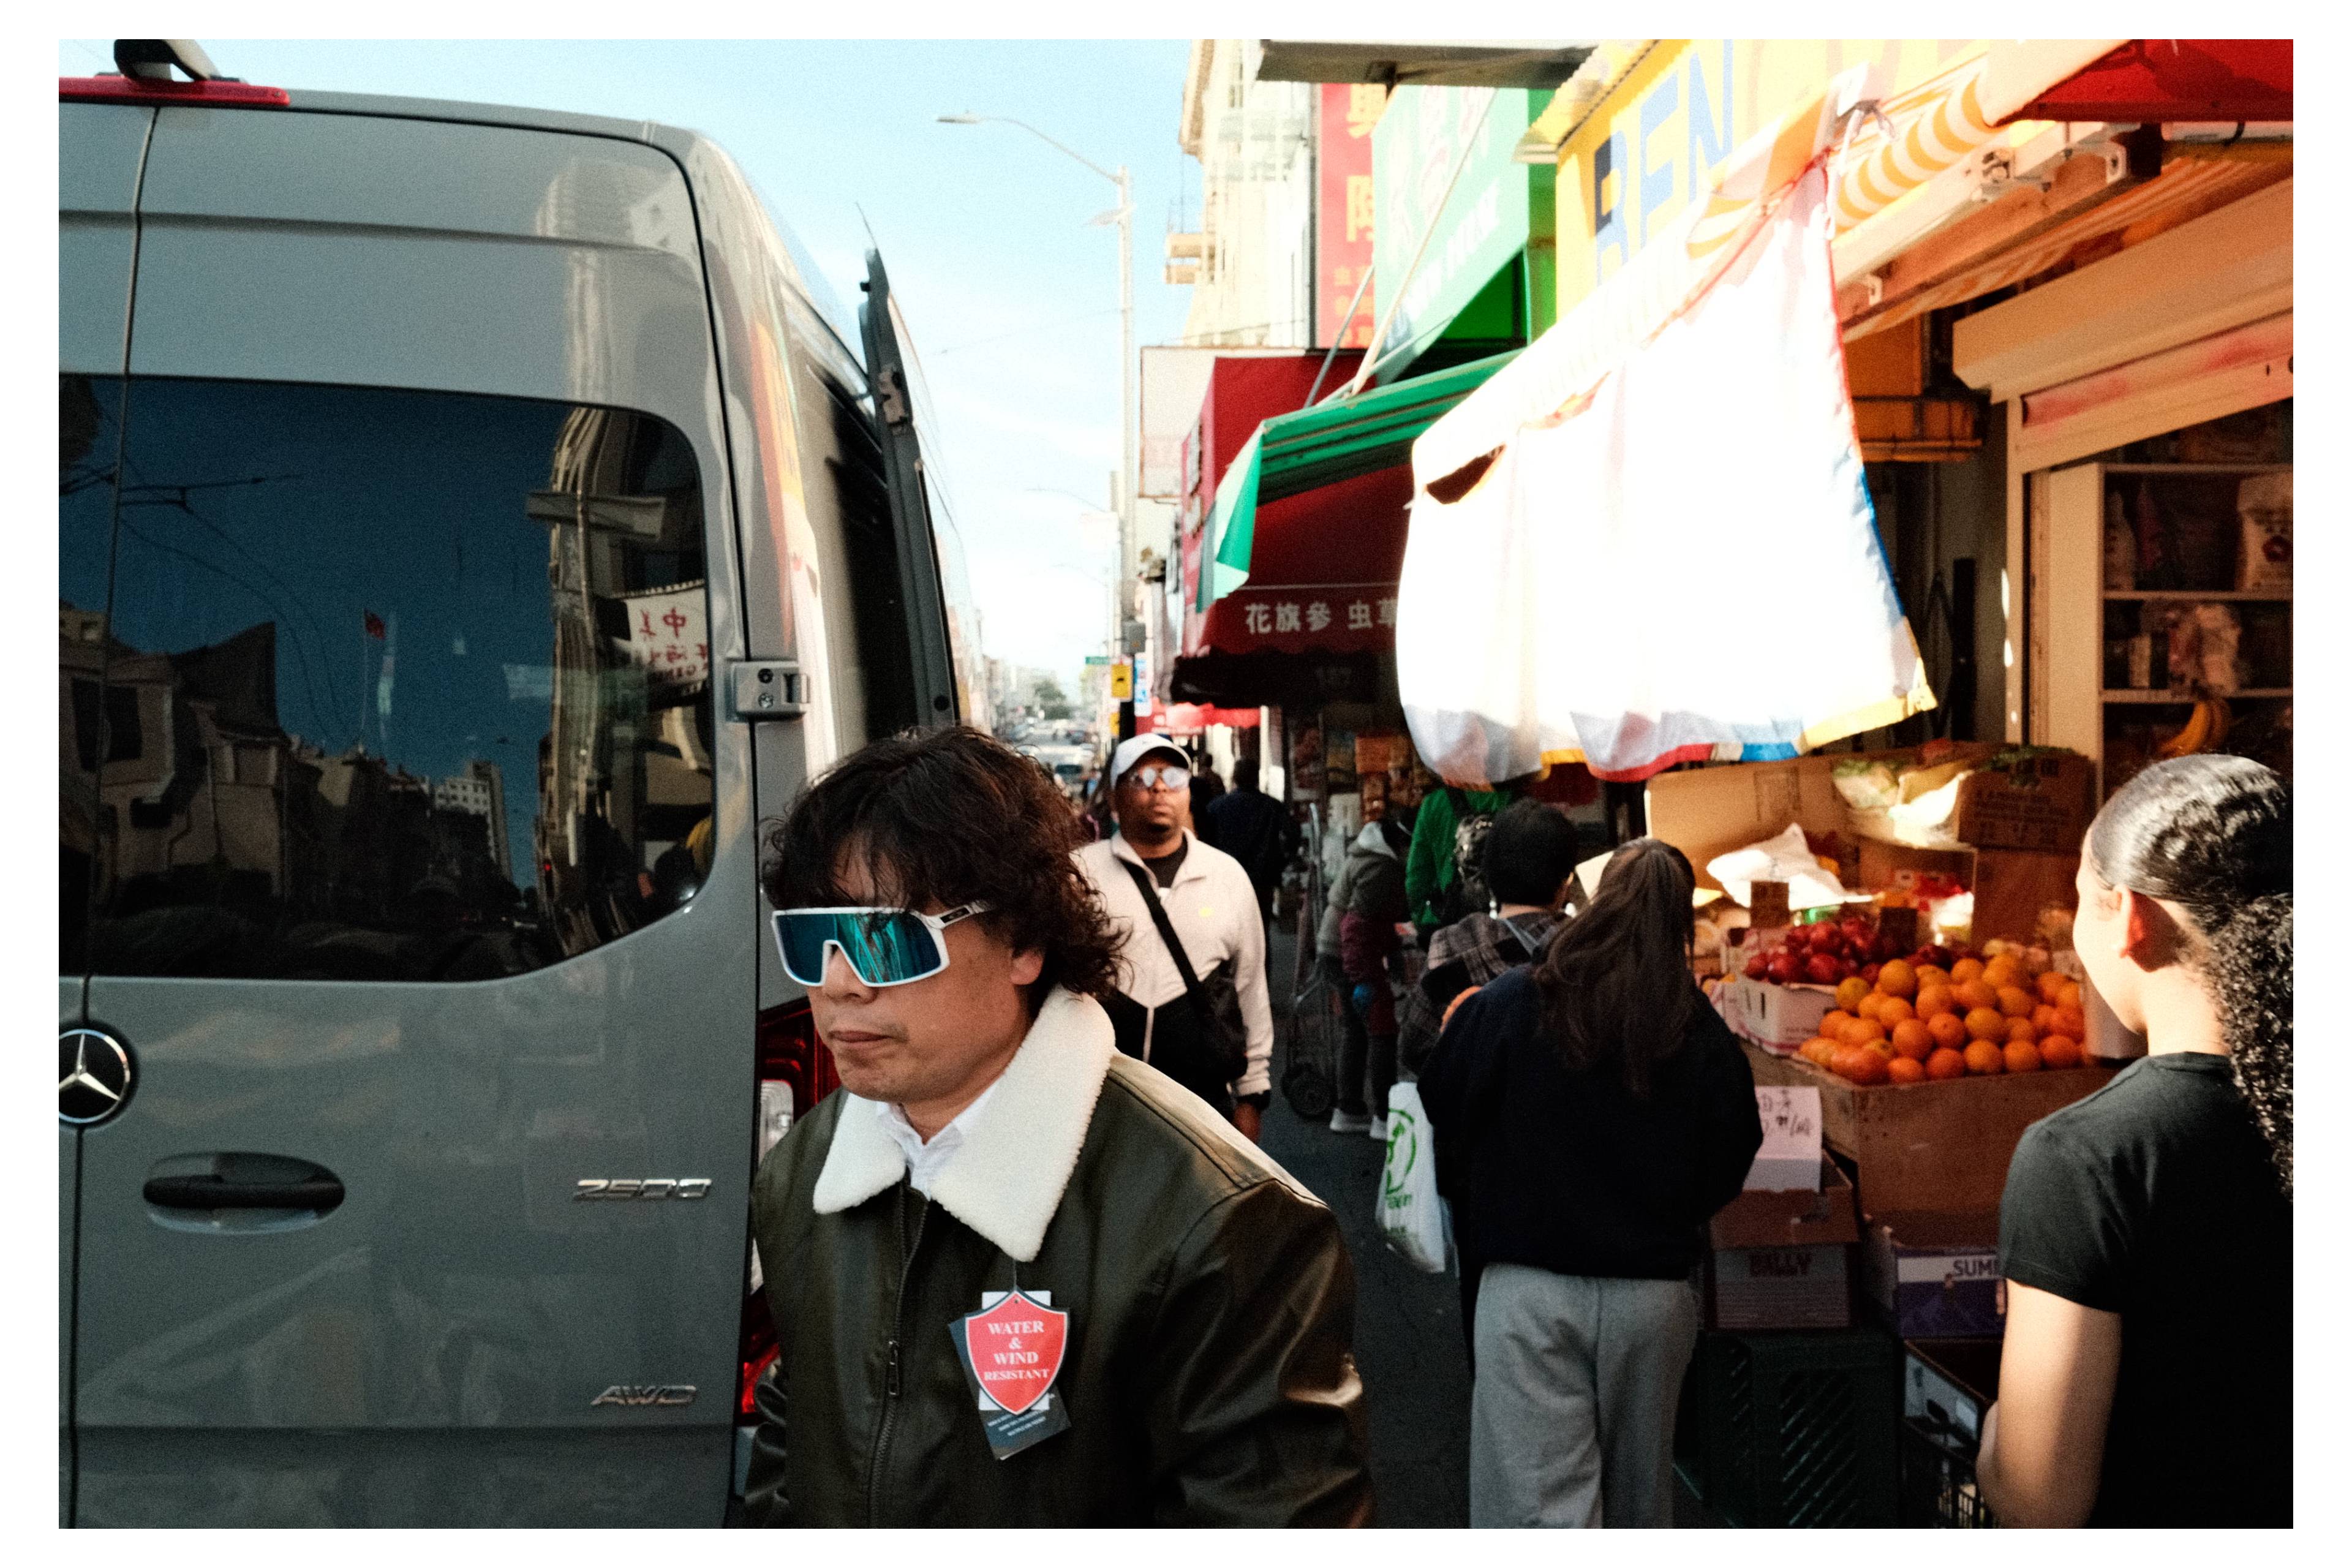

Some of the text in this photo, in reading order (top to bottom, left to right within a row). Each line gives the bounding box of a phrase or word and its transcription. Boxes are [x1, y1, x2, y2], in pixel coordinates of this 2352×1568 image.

[573, 1178, 712, 1200] 2500
[987, 1321, 1044, 1334] WATER
[1009, 1337, 1022, 1349] &
[993, 1351, 1039, 1365] WIND
[984, 1368, 1050, 1381] RESISTANT
[590, 1385, 697, 1406] AWD
